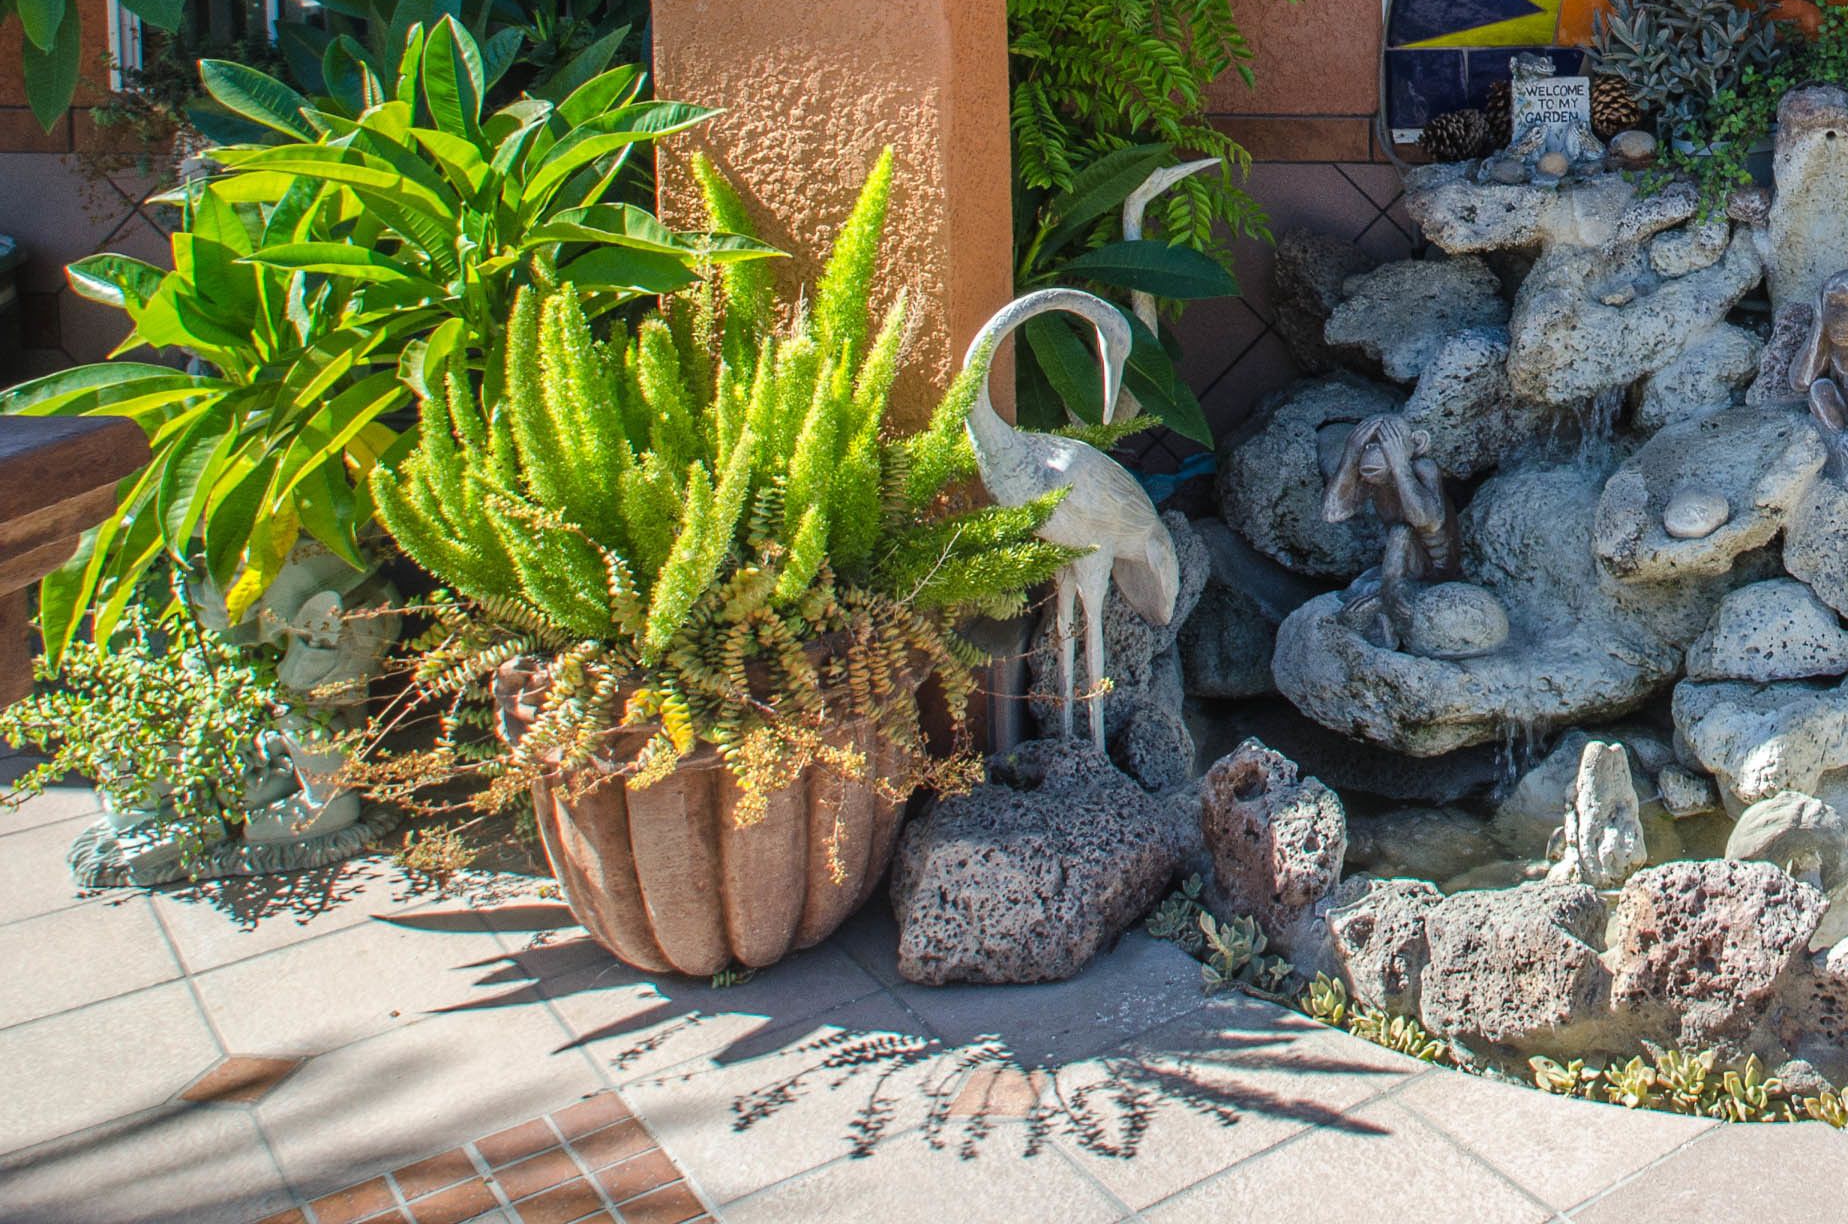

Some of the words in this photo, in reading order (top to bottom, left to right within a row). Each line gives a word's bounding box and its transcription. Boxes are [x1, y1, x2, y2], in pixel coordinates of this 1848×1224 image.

[1525, 84, 1585, 97] WELCOME
[1538, 98, 1555, 110] TO
[1559, 97, 1579, 110] MY
[1524, 111, 1579, 124] GARDEN
